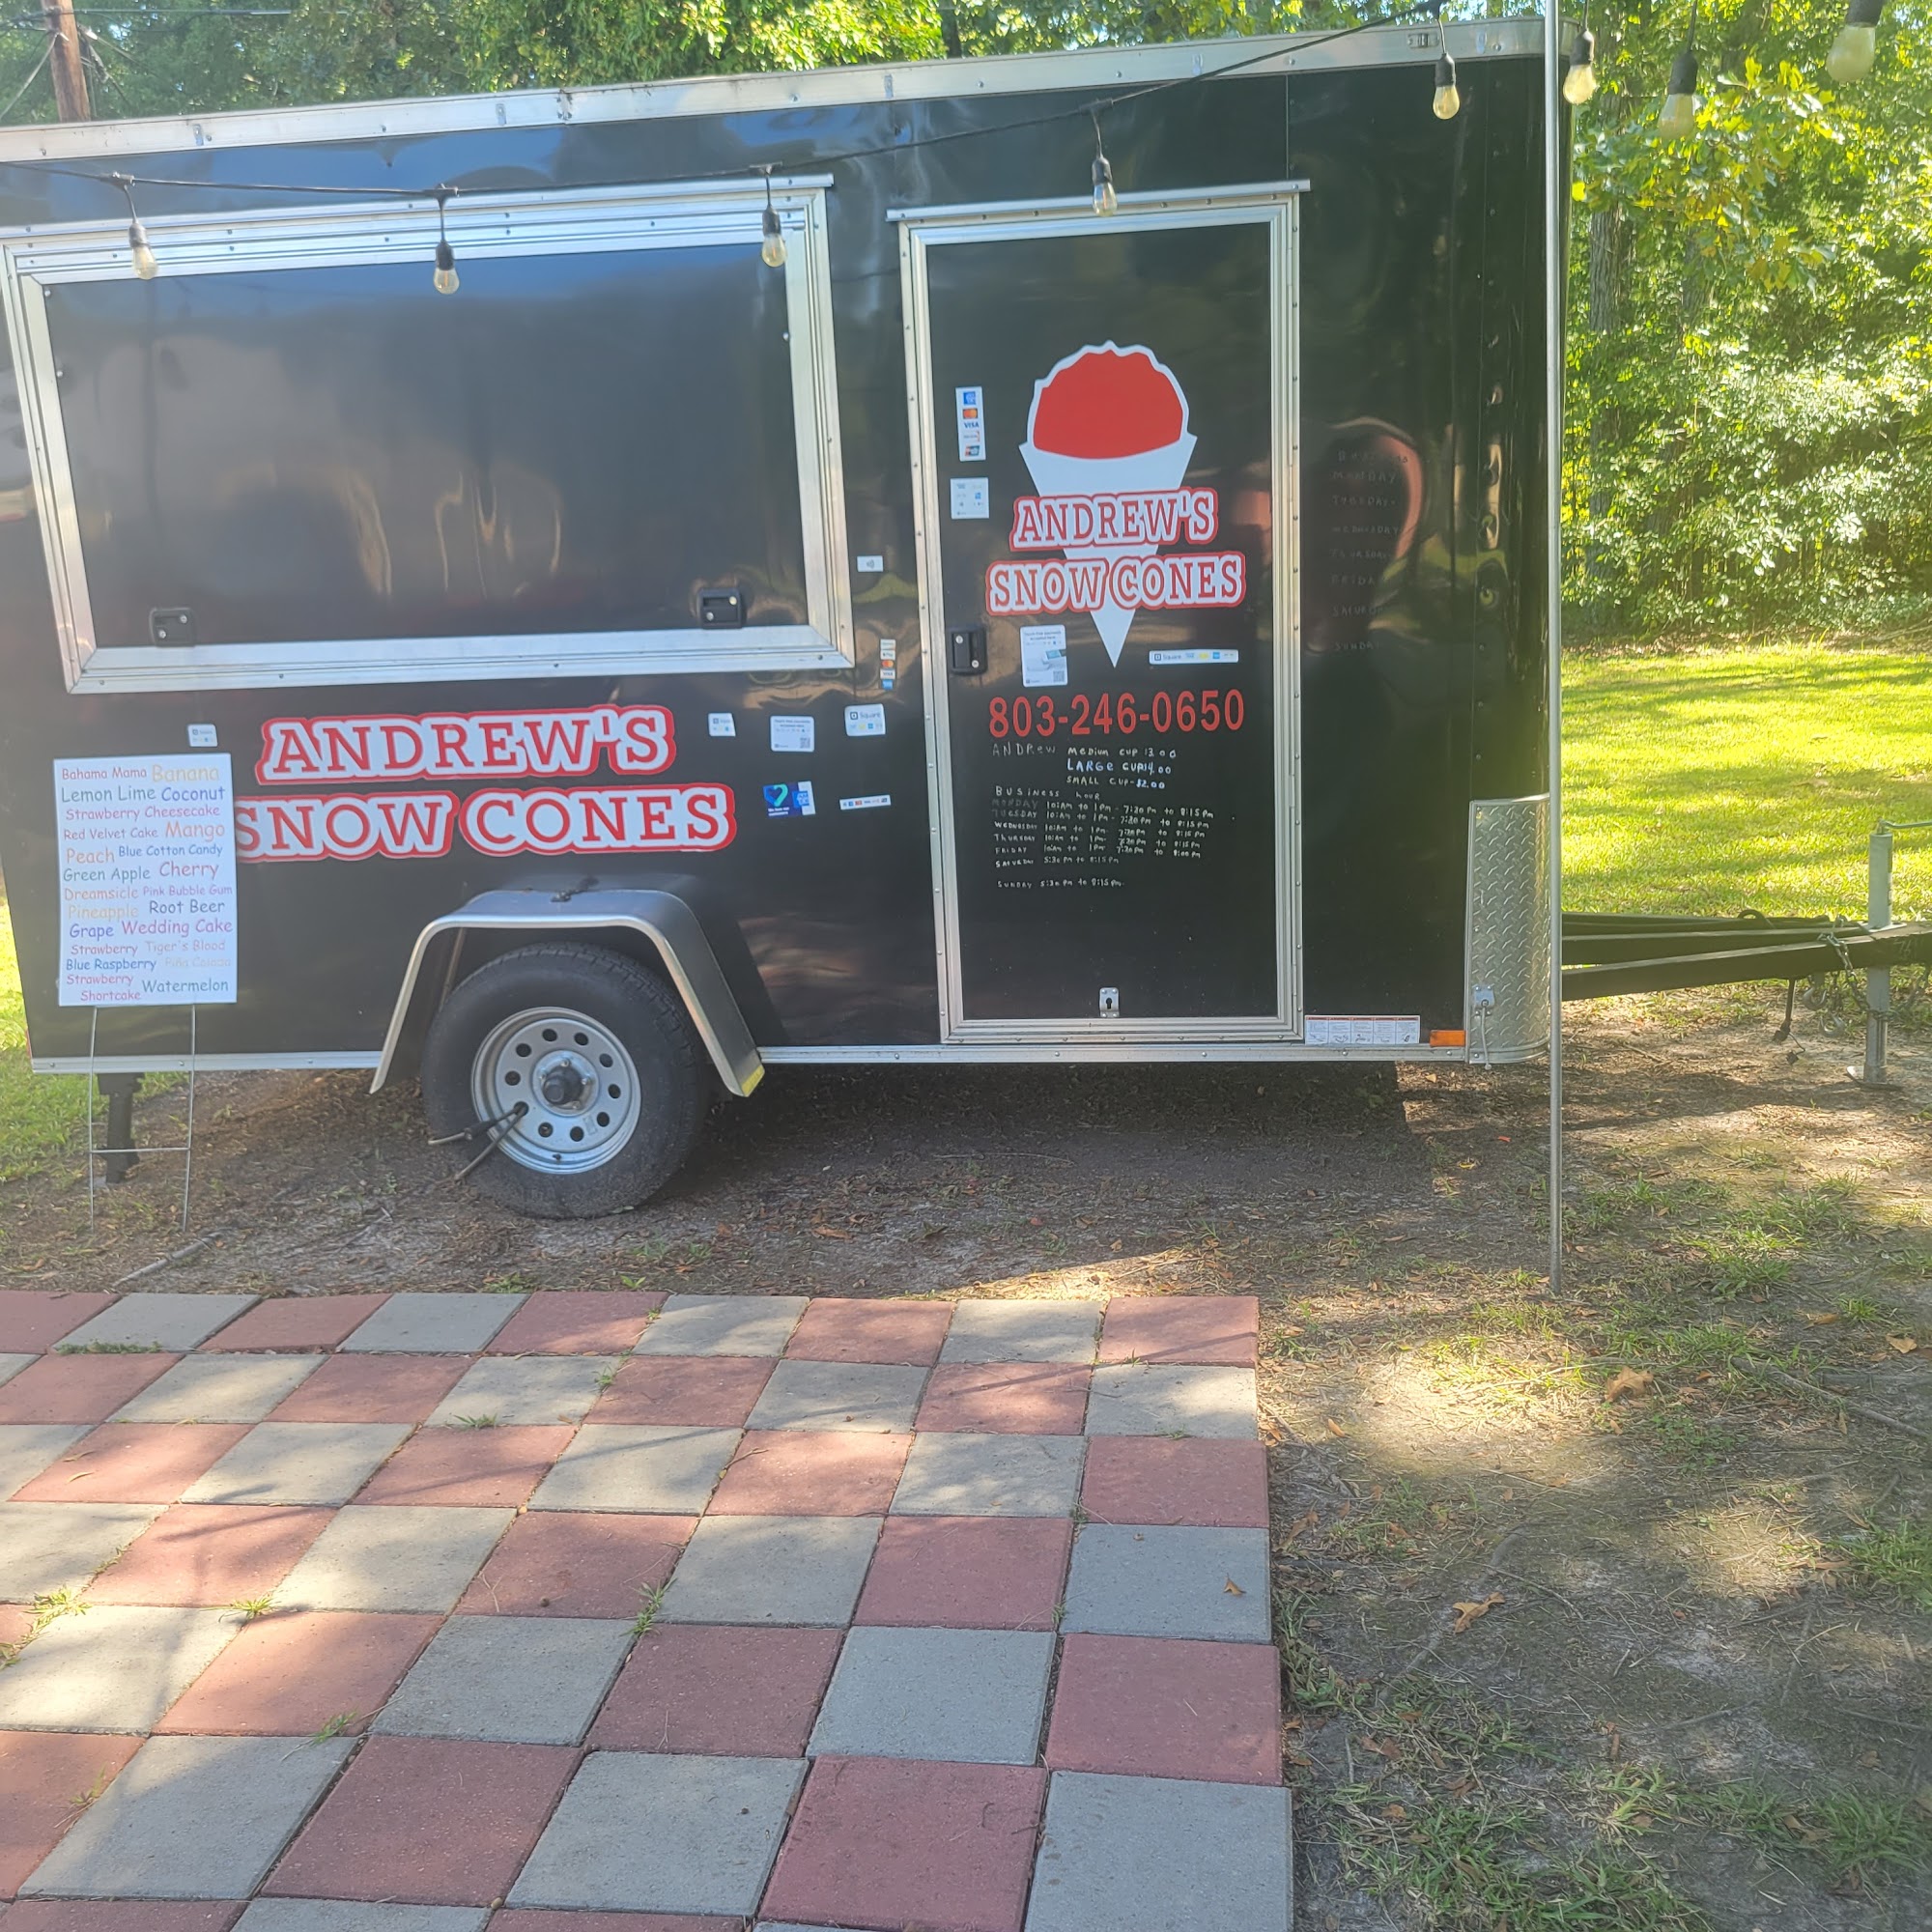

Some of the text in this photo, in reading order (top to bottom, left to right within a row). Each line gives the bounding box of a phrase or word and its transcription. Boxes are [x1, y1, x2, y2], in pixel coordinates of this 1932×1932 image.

[1014, 490, 1215, 547] ANDREW'S
[990, 555, 1241, 611] SNOW CONES
[989, 690, 1244, 738] 803-246-0650
[265, 709, 668, 780] ANDREW'S
[62, 764, 220, 782] Bahama Mama Banana
[61, 785, 225, 803] Lemon Lime Coconut
[66, 805, 220, 823] Strawberry Cheesecake
[234, 788, 733, 859] SNOW CONES
[64, 820, 225, 842] Red Velvet Cake Mango
[66, 844, 223, 864] Peach Blue Cotton Candy
[63, 861, 219, 884] Green Apple Cherry
[64, 885, 233, 900] Dreamsicle Pink Bubble Gum
[68, 899, 225, 922] Pineapple Root Beer
[70, 918, 233, 941] Grape Wedding Cake
[71, 944, 138, 956] Strawberry
[192, 940, 226, 952] Blood
[66, 959, 90, 971] Blue
[95, 958, 157, 973] Raspberry
[66, 975, 133, 985] Strawberry
[81, 978, 229, 1001] Shortcake Watermelon
